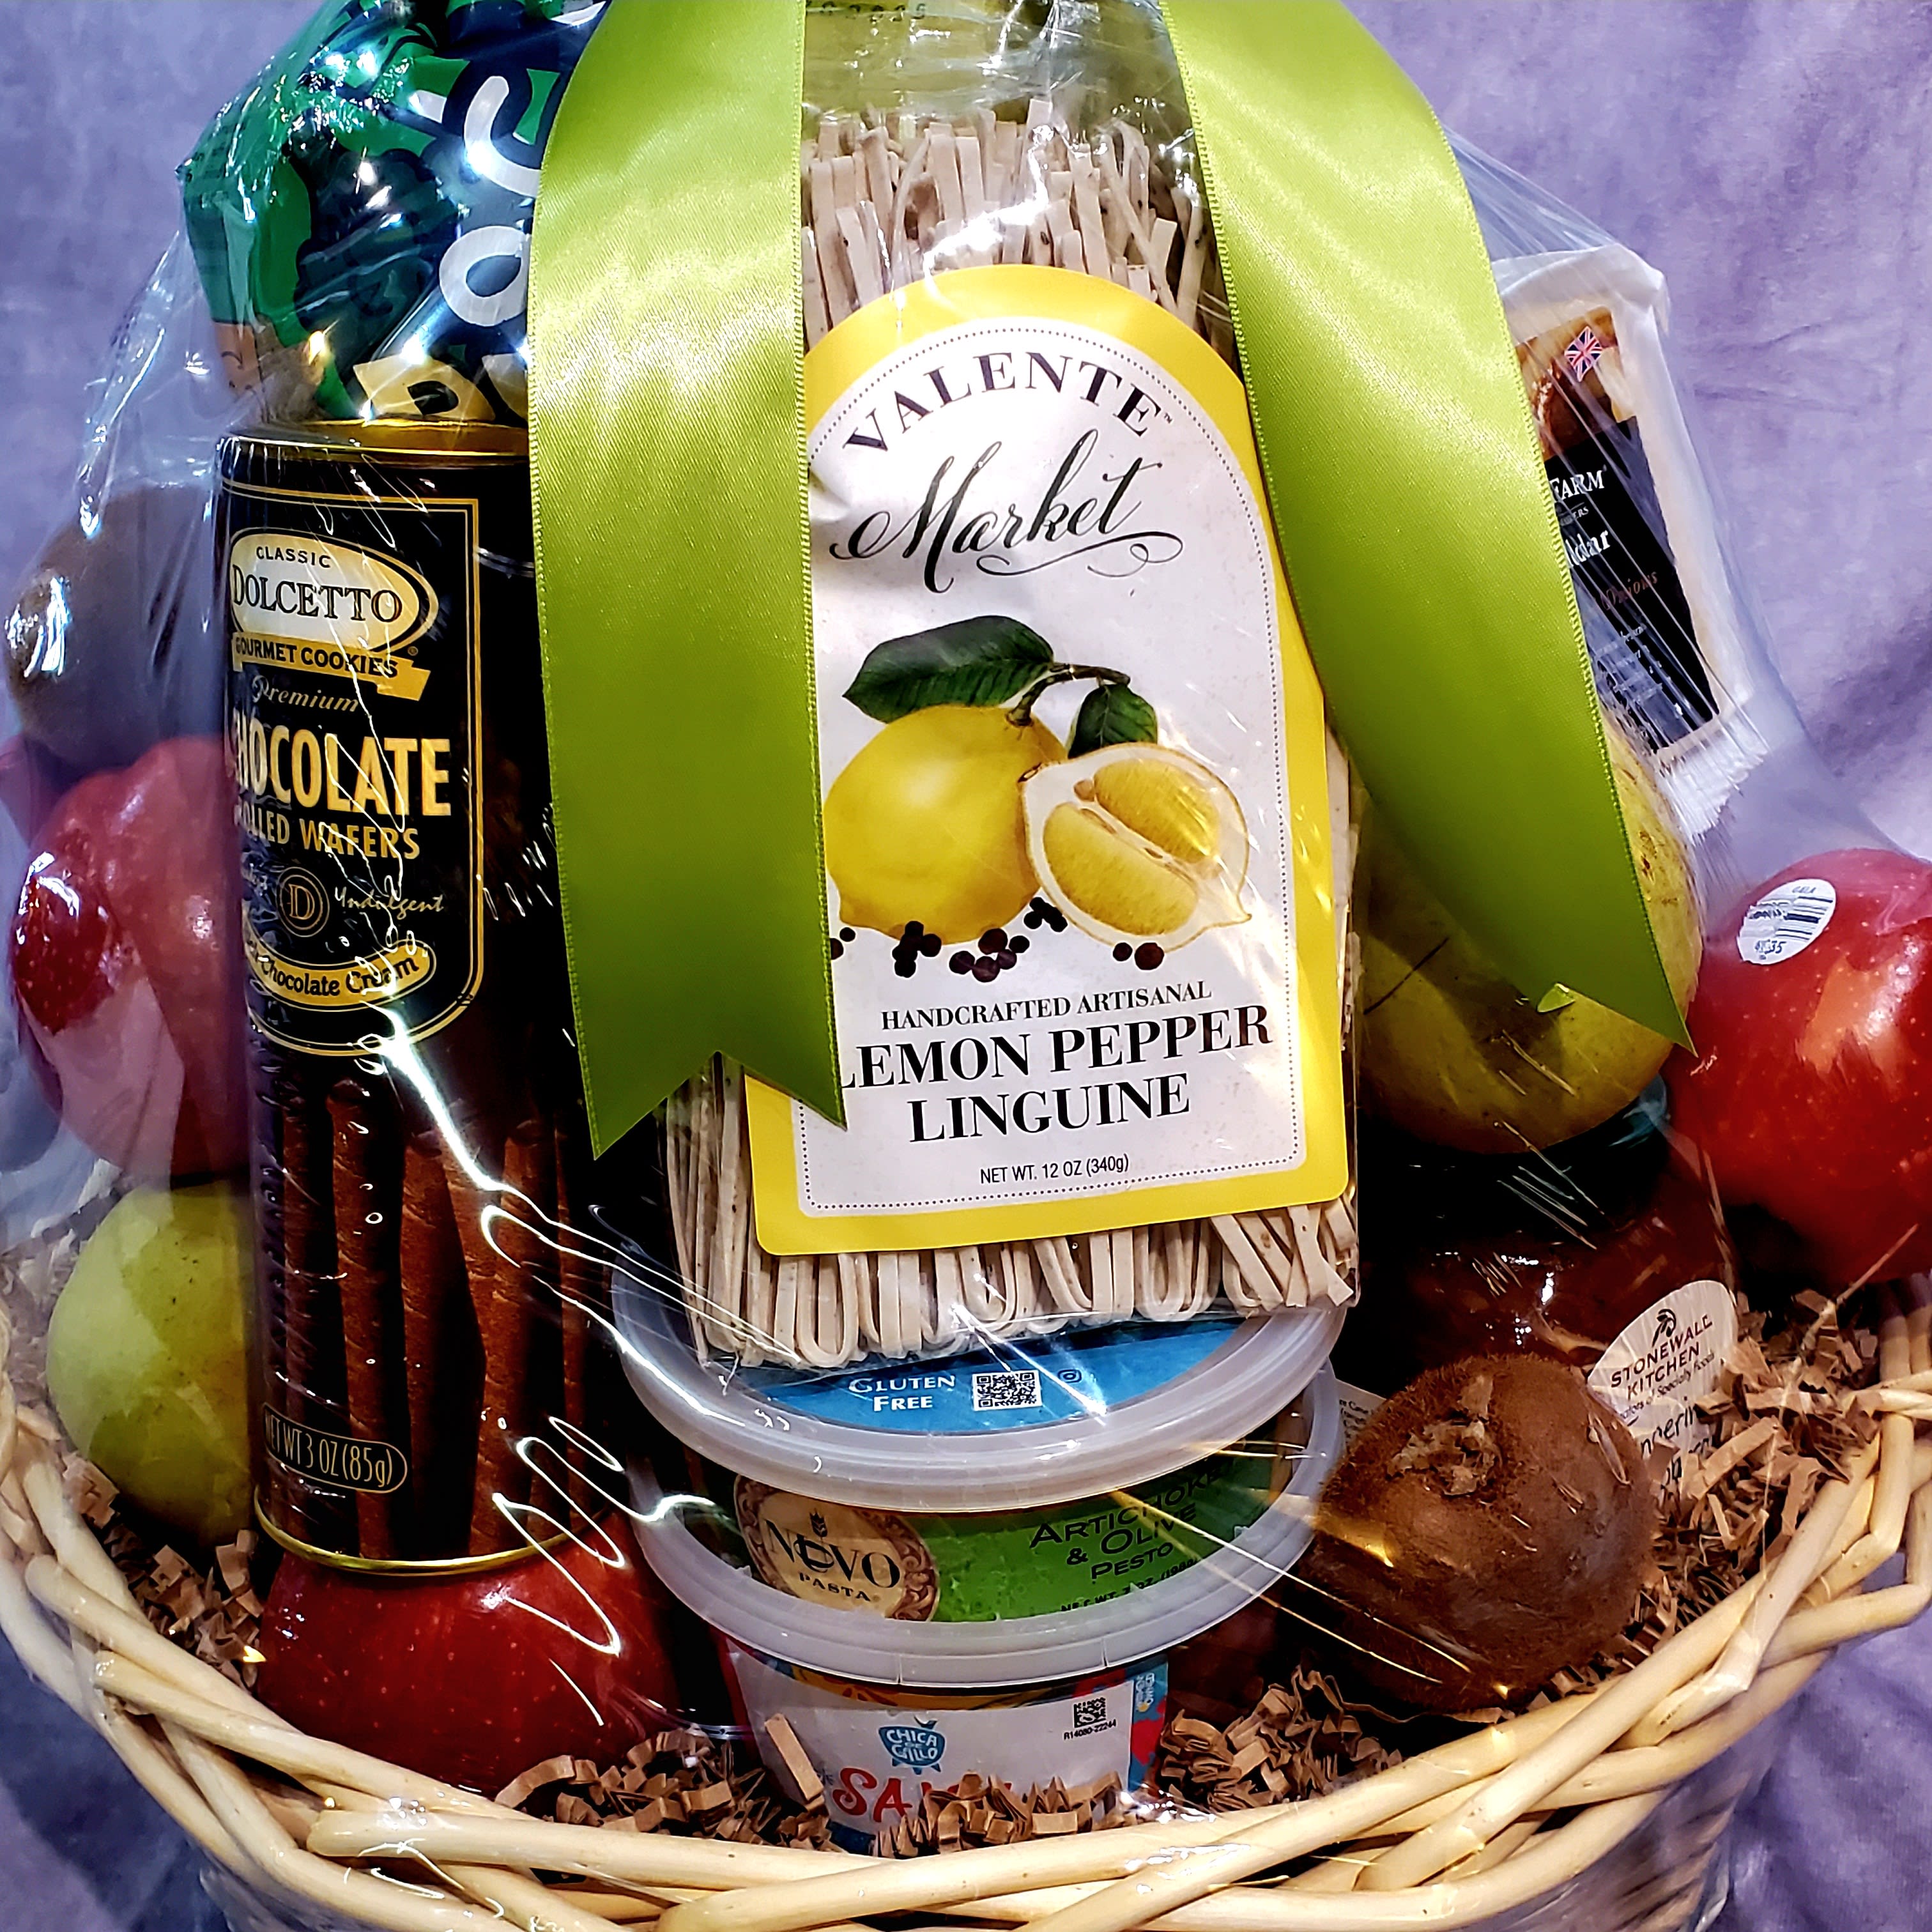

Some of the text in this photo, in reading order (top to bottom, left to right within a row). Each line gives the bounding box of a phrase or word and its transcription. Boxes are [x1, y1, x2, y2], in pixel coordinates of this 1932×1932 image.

[843, 352, 1161, 452] VALENTE
[829, 428, 1183, 593] Market
[256, 546, 332, 568] CLASSIC
[233, 565, 402, 622] DOLCETTO
[235, 639, 398, 678] GOURMET COOKIES
[252, 675, 359, 712] Premium
[234, 708, 452, 816] HOCOLATE
[234, 800, 289, 845] OLLED
[299, 817, 420, 861] WAFERS
[881, 980, 1211, 1031] HANDCRAFTED ARTISANAL
[1050, 1004, 1273, 1073] PEPPER
[907, 1072, 1191, 1143] LINGUINE
[980, 1155, 1130, 1185] NET WT. 12 OZ (340g)
[848, 1375, 956, 1393] GLUTEN
[1627, 1342, 1700, 1401] KITCHEN
[873, 1395, 933, 1411] FREE
[283, 1422, 302, 1465] WT
[305, 1433, 313, 1468] 3
[319, 1439, 339, 1476] OZ
[342, 1443, 393, 1488] (85g)
[1066, 1503, 1197, 1565] & OLIVE
[1091, 1542, 1174, 1580] PESTO
[799, 1572, 871, 1602] PASTA
[886, 1729, 937, 1747] CHICA
